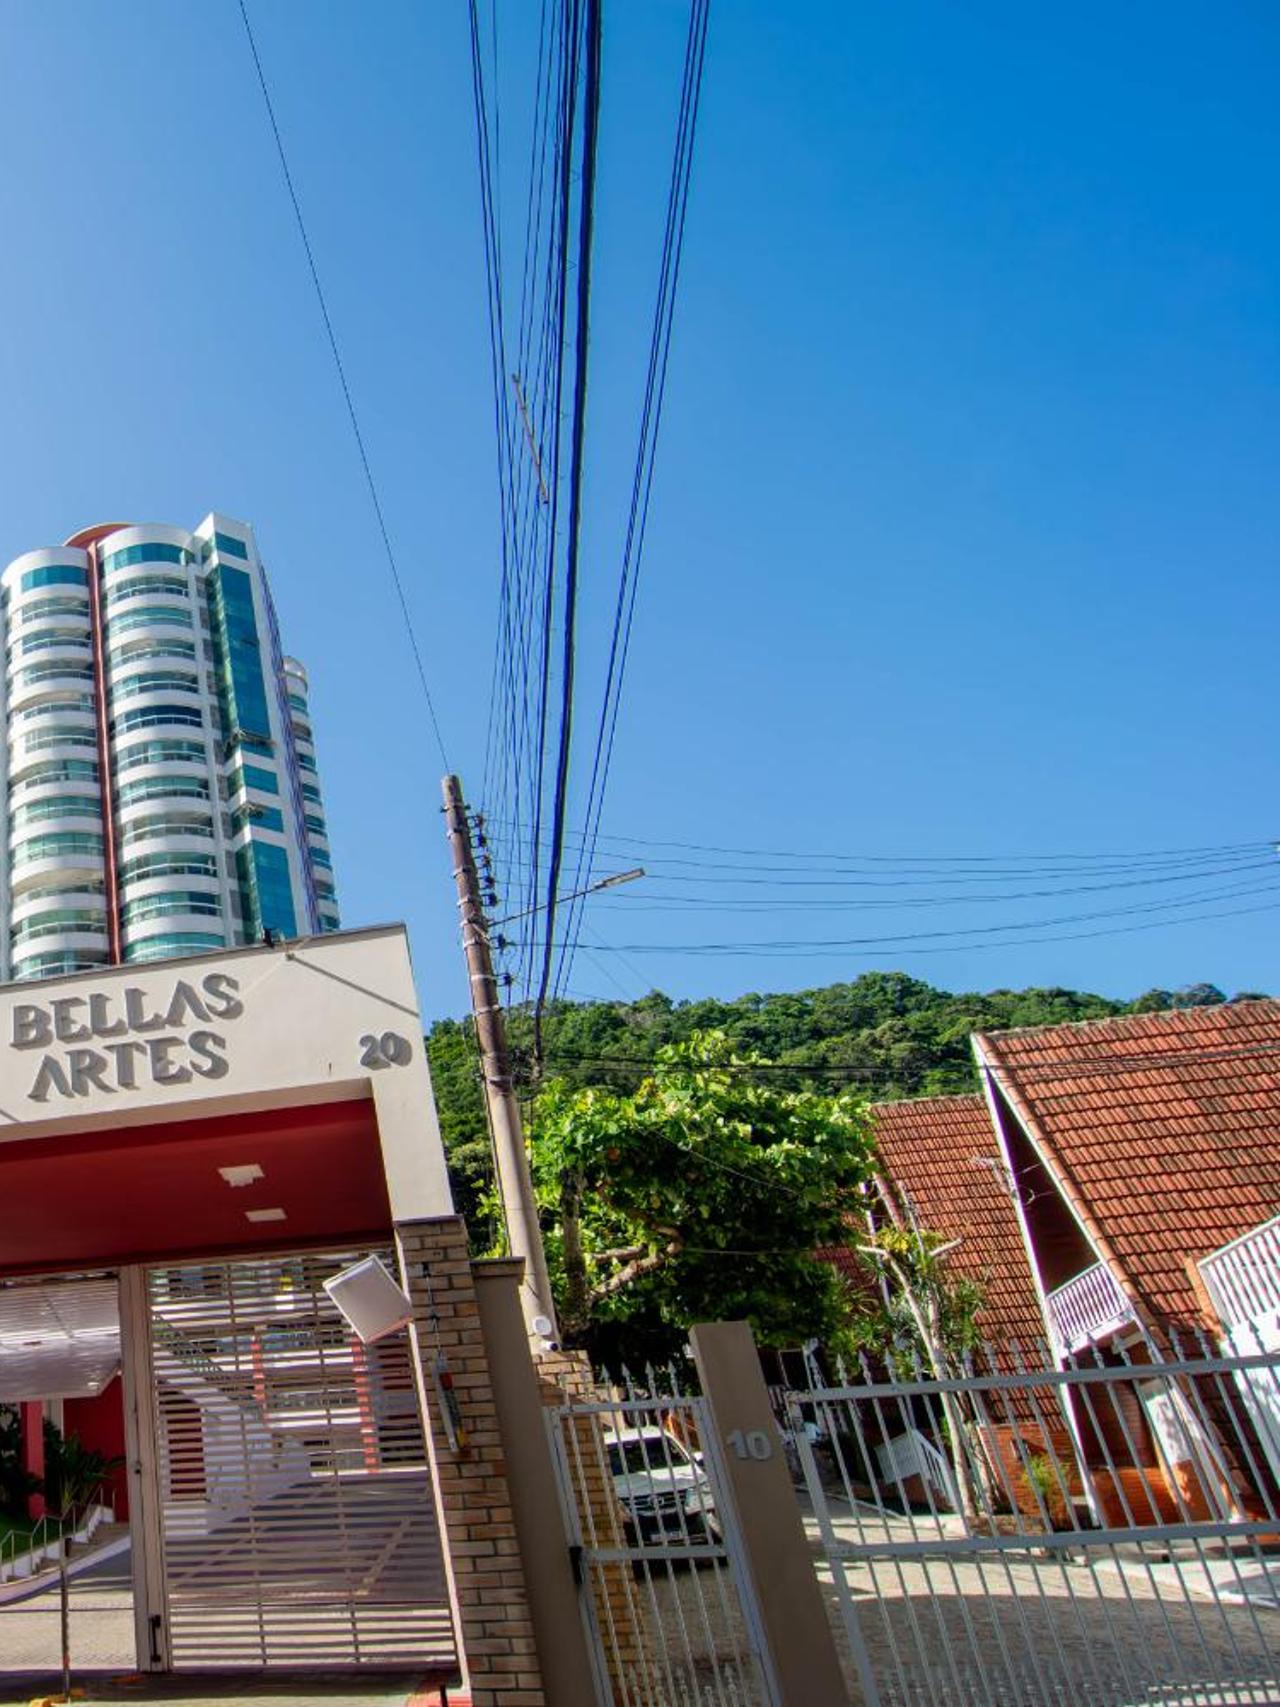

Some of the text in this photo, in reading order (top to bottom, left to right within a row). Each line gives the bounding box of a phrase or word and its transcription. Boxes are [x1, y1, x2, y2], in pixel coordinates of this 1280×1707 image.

[10, 973, 244, 1049] BELLAS
[27, 1030, 229, 1102] ARTES
[359, 1031, 410, 1069] 20
[726, 1430, 770, 1459] 10
